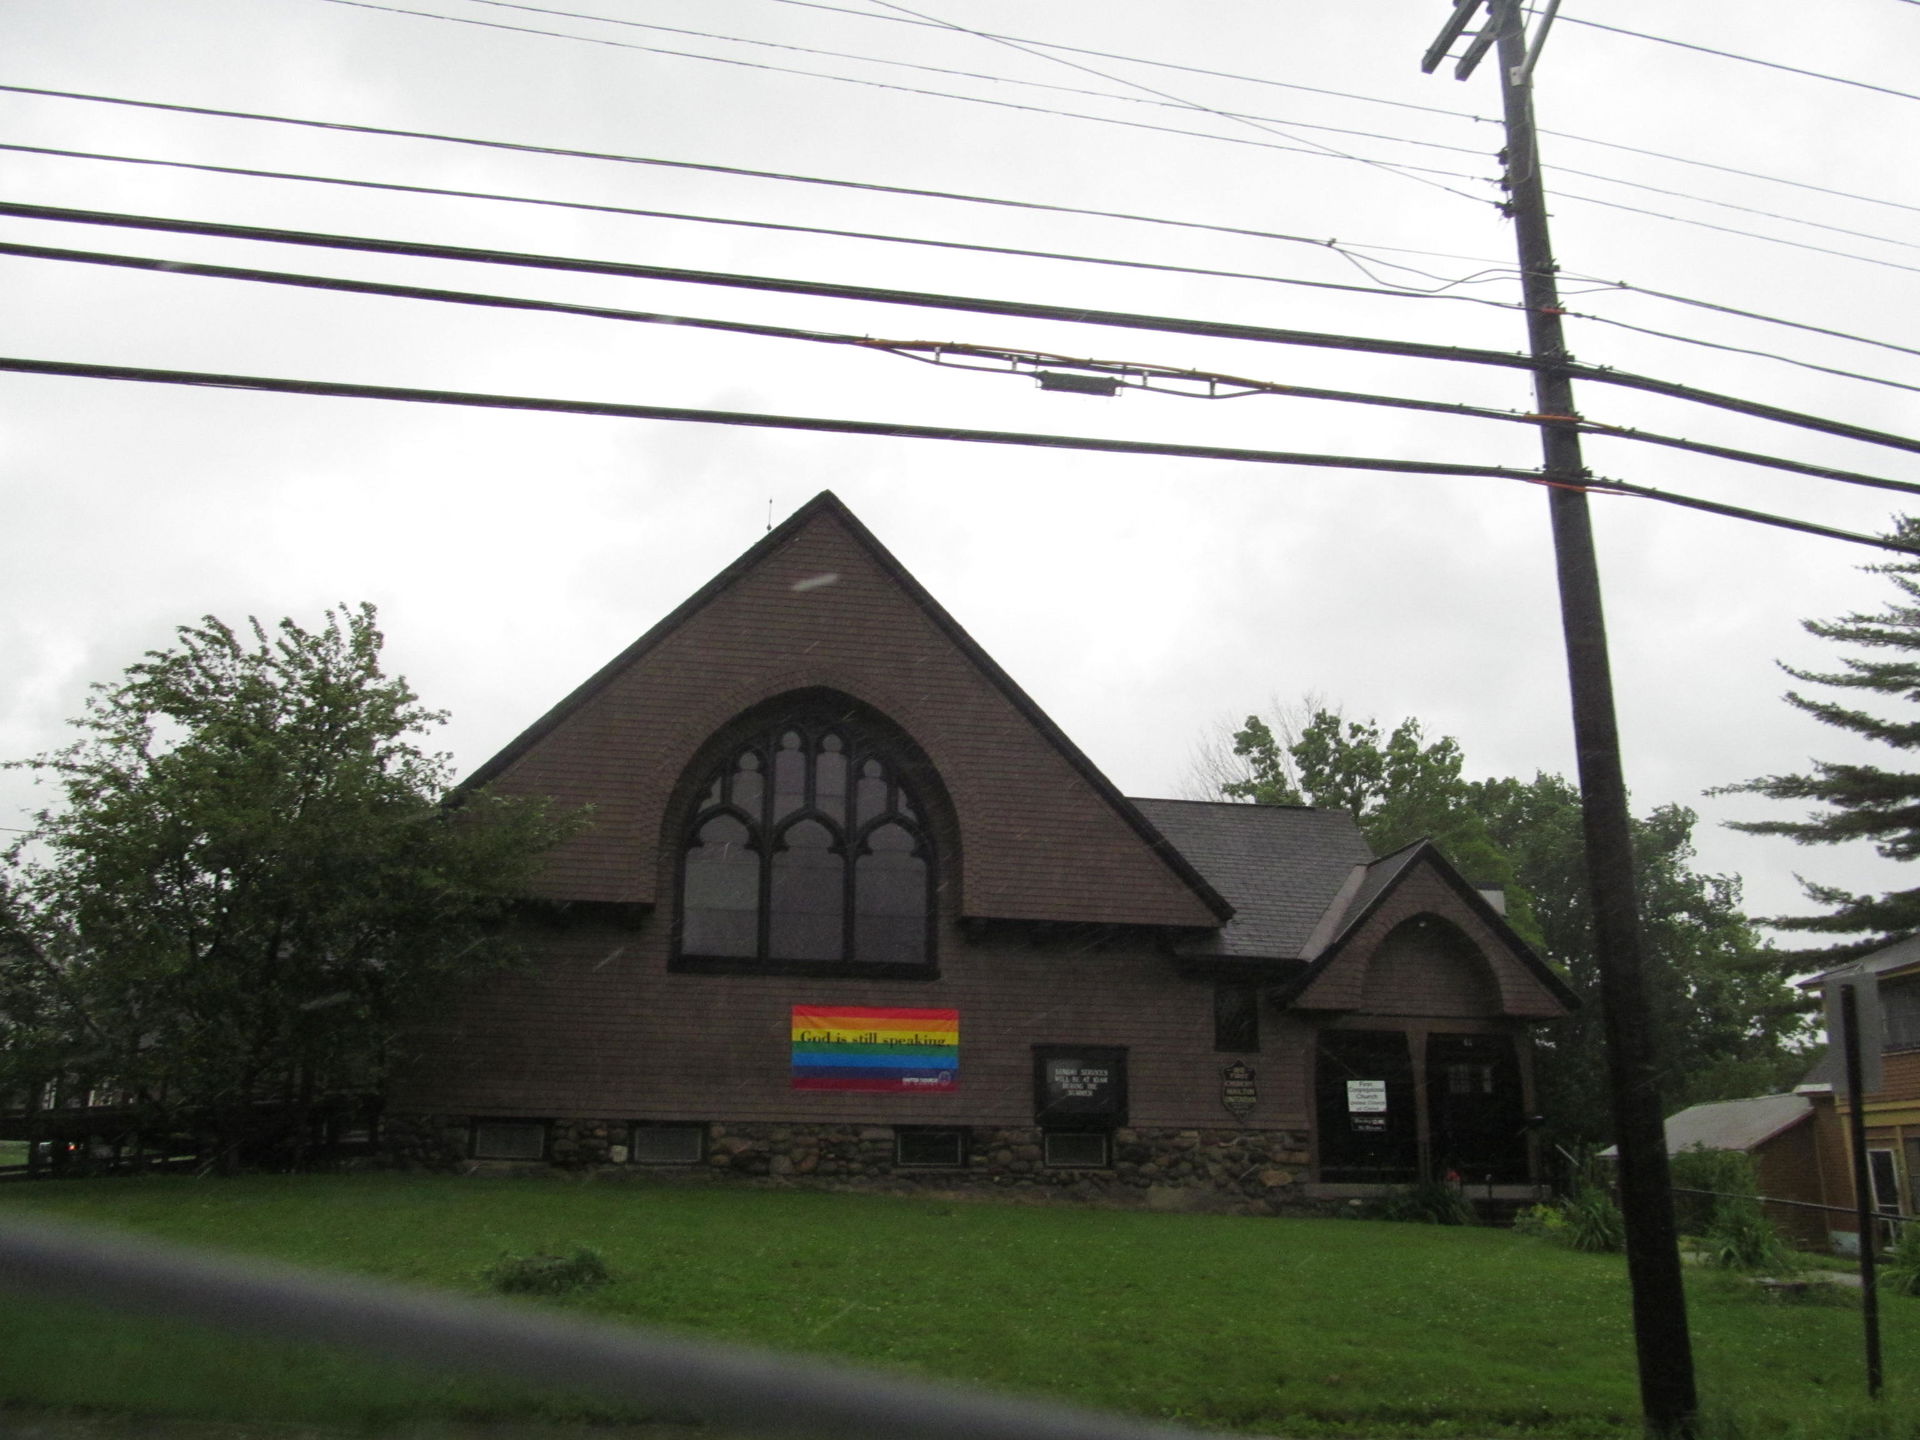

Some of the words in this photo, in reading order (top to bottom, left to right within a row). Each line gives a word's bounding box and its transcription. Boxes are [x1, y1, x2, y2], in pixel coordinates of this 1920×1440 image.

[800, 1031, 831, 1043] God
[837, 1033, 847, 1043] is
[852, 1032, 877, 1044] still
